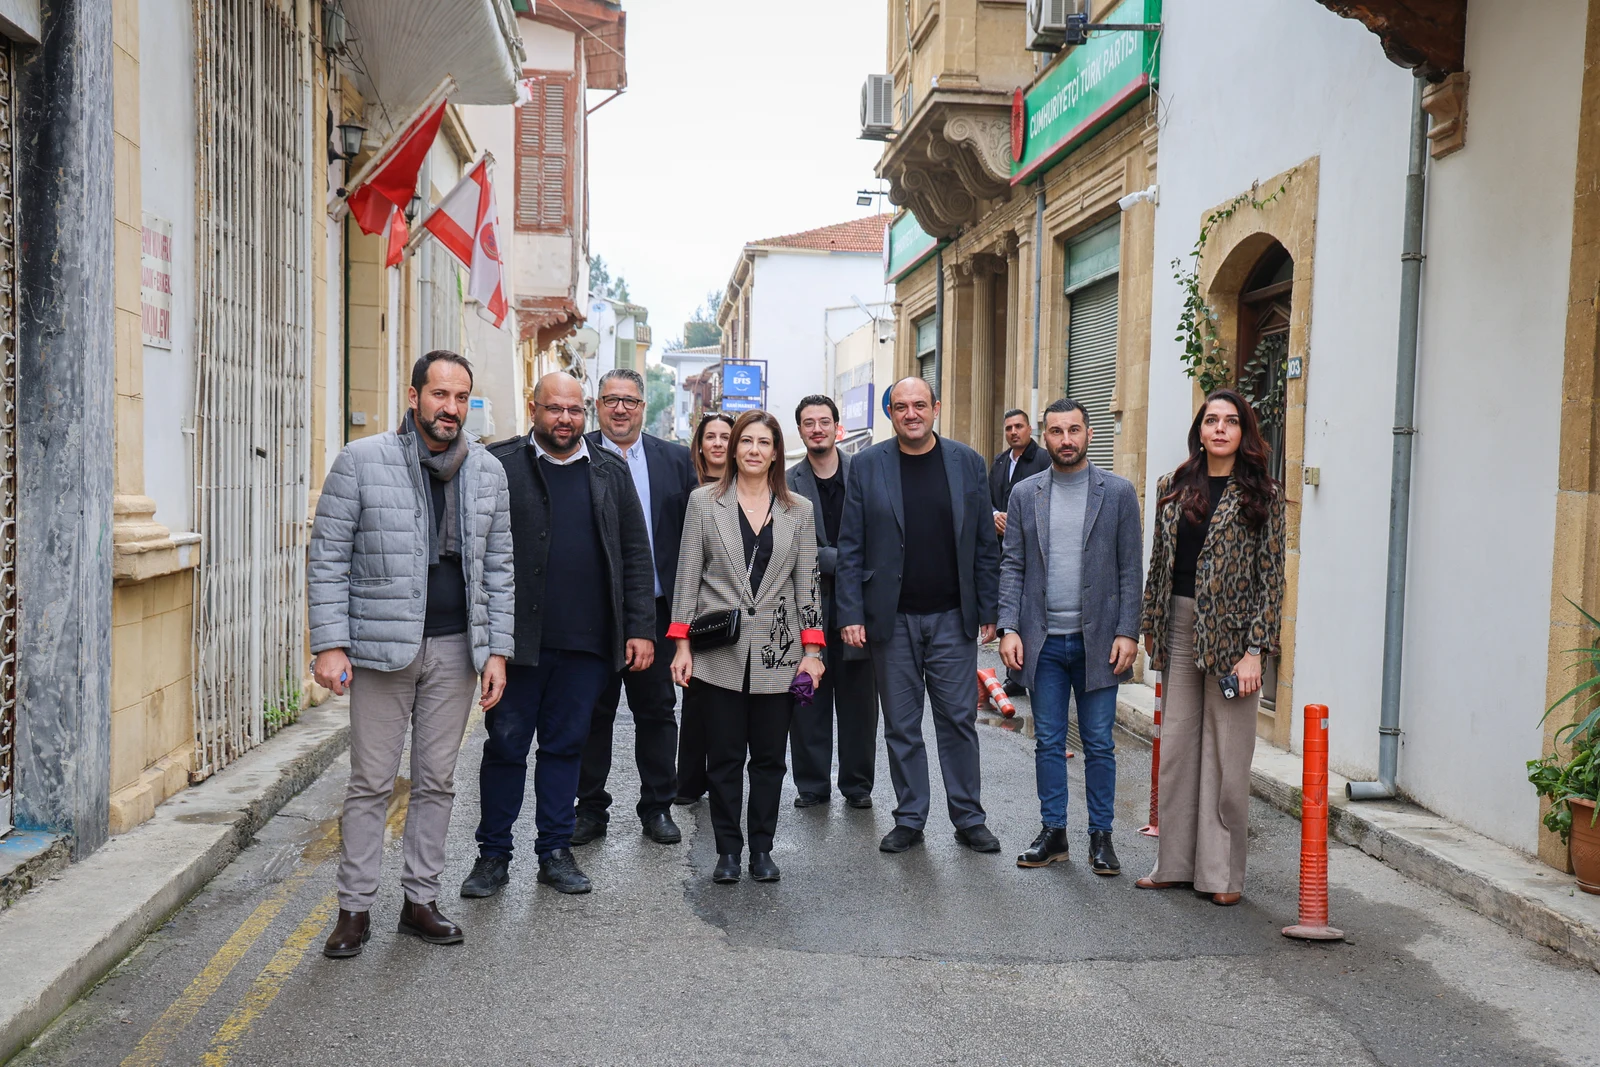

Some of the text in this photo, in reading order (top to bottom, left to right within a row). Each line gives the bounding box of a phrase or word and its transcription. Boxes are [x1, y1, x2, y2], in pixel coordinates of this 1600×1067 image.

[1030, 68, 1079, 139] CUMHURİYETÇİ
[1080, 55, 1103, 97] TÜRK
[733, 377, 751, 385] EFES
